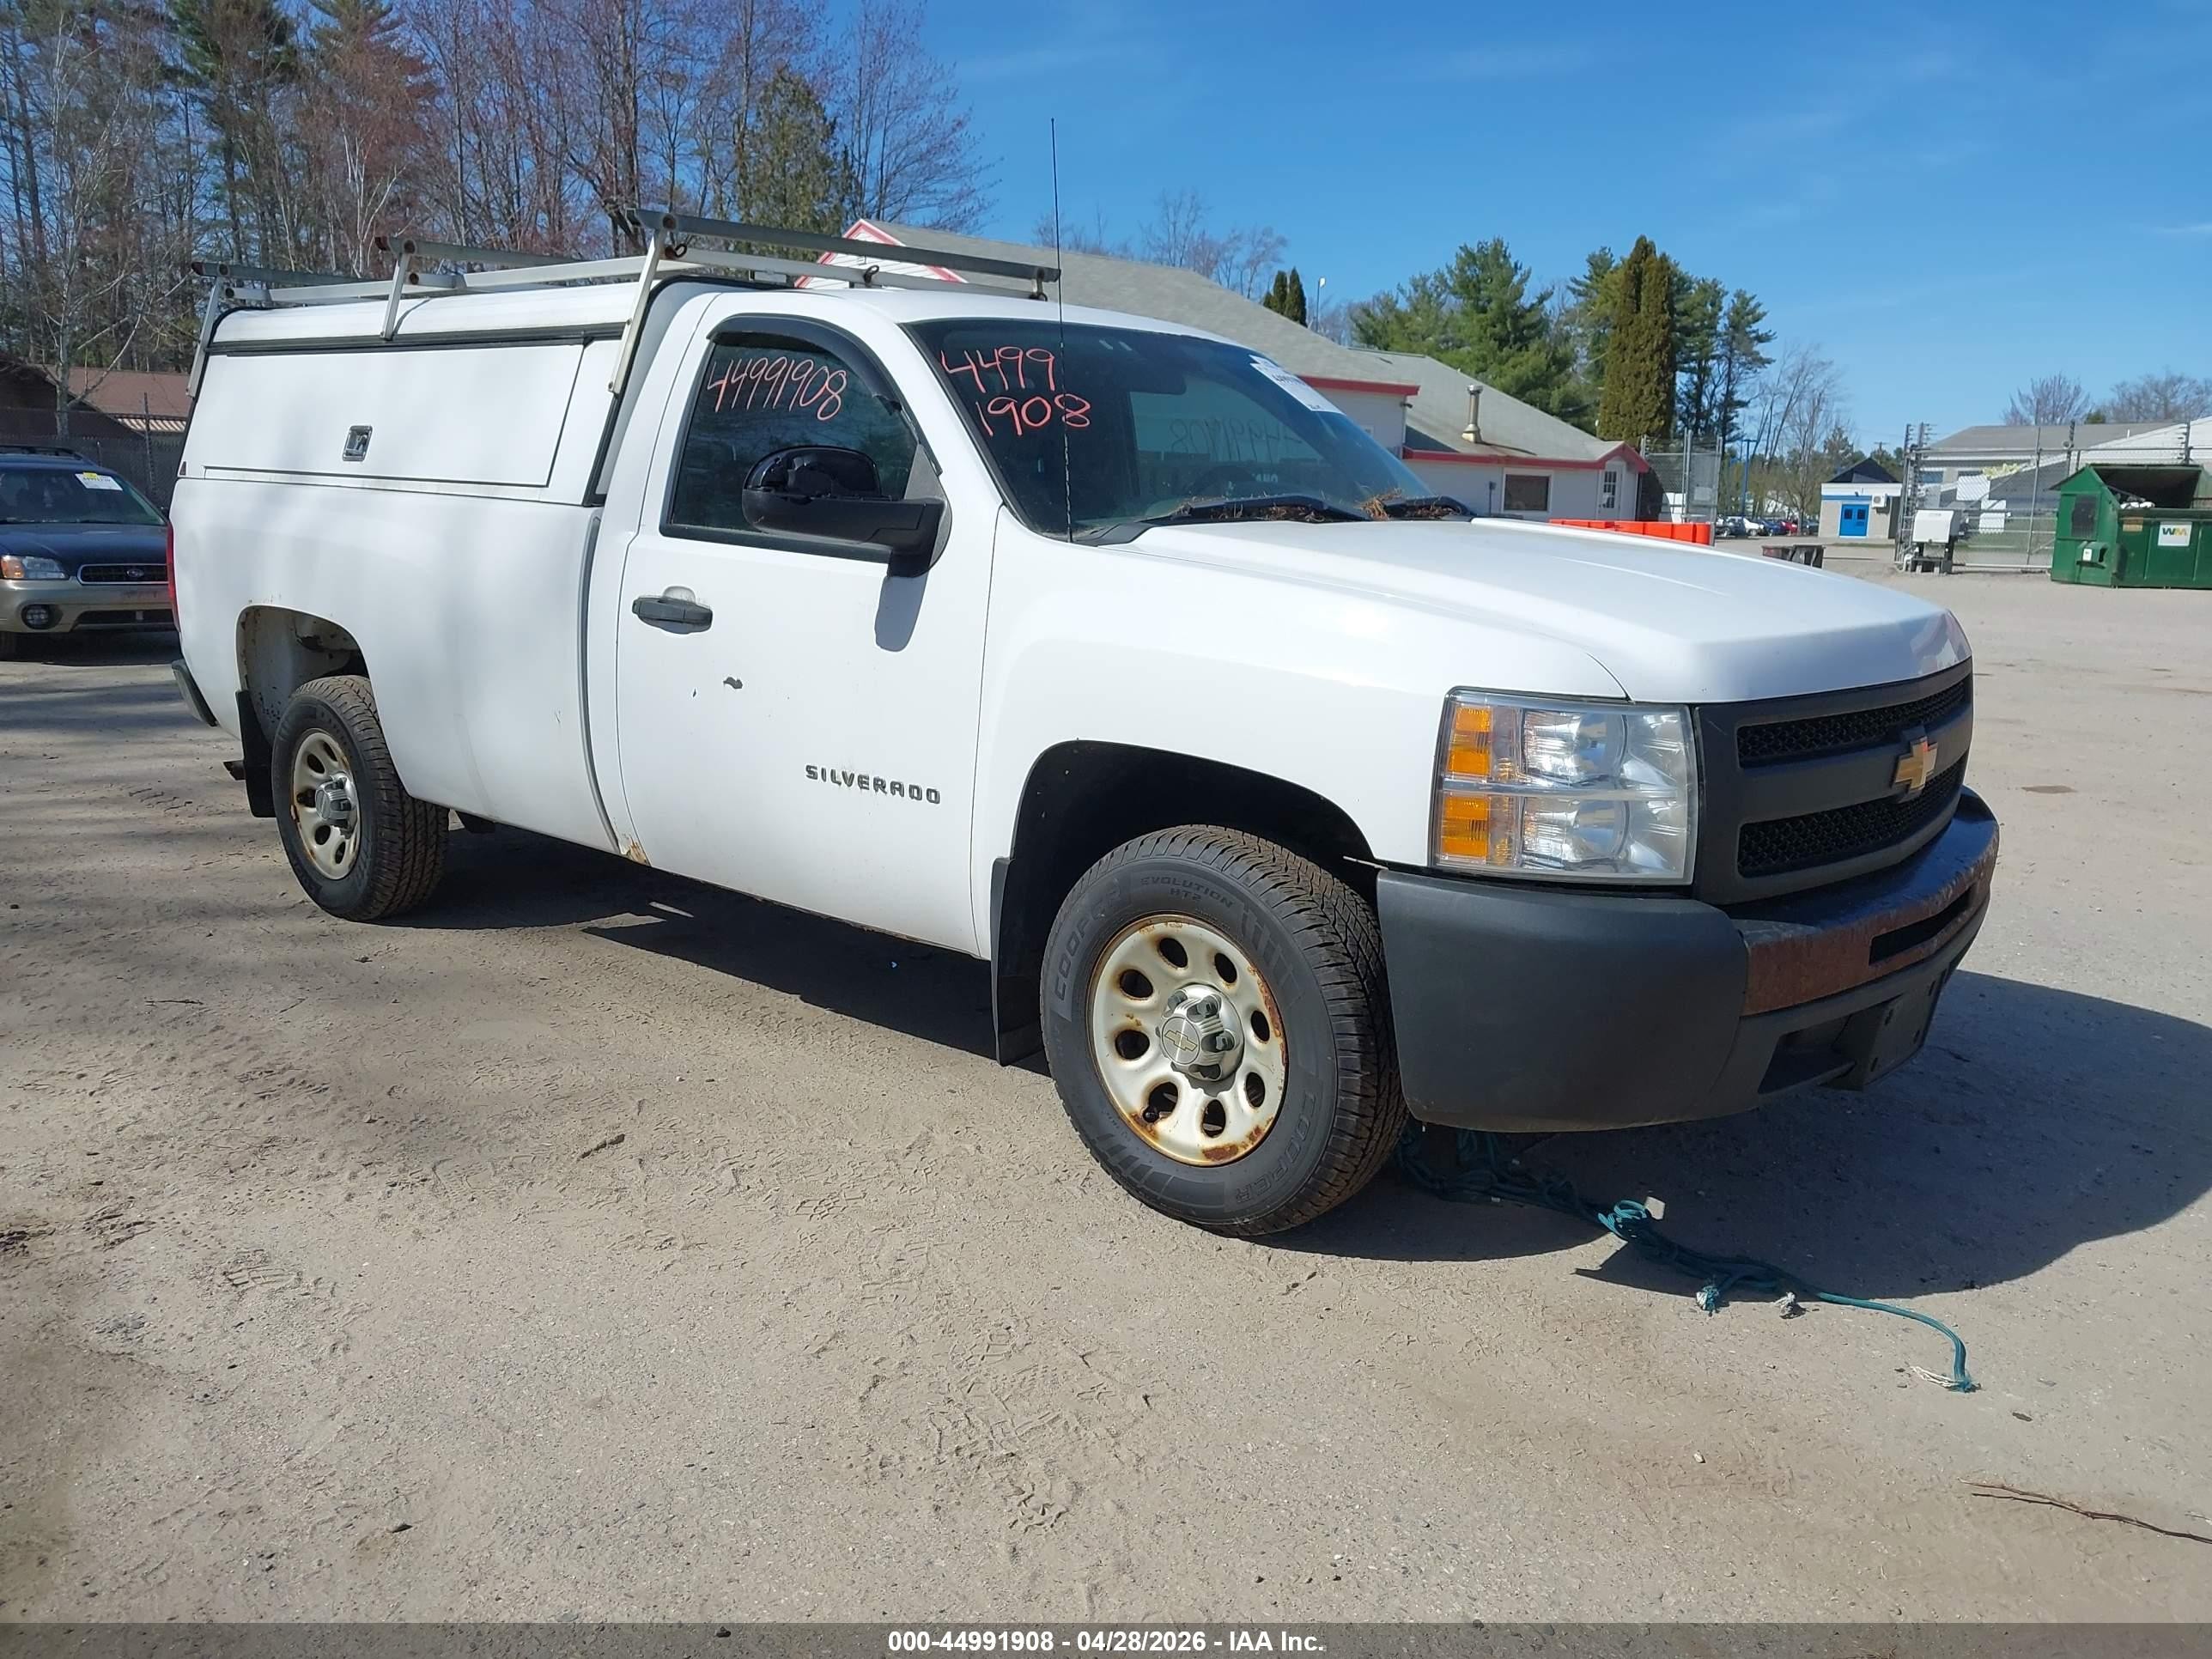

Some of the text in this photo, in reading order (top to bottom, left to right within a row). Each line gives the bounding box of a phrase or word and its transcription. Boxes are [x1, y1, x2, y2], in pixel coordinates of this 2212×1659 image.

[707, 356, 847, 421] 44991908
[940, 346, 1054, 393] 4499
[975, 393, 1091, 436] 1908
[2162, 527, 2187, 536] WM
[805, 764, 940, 805] SILVERADO
[1140, 876, 1233, 908] EVOLUTION
[1170, 887, 1202, 902] HT2
[1237, 1090, 1316, 1202] COOPER
